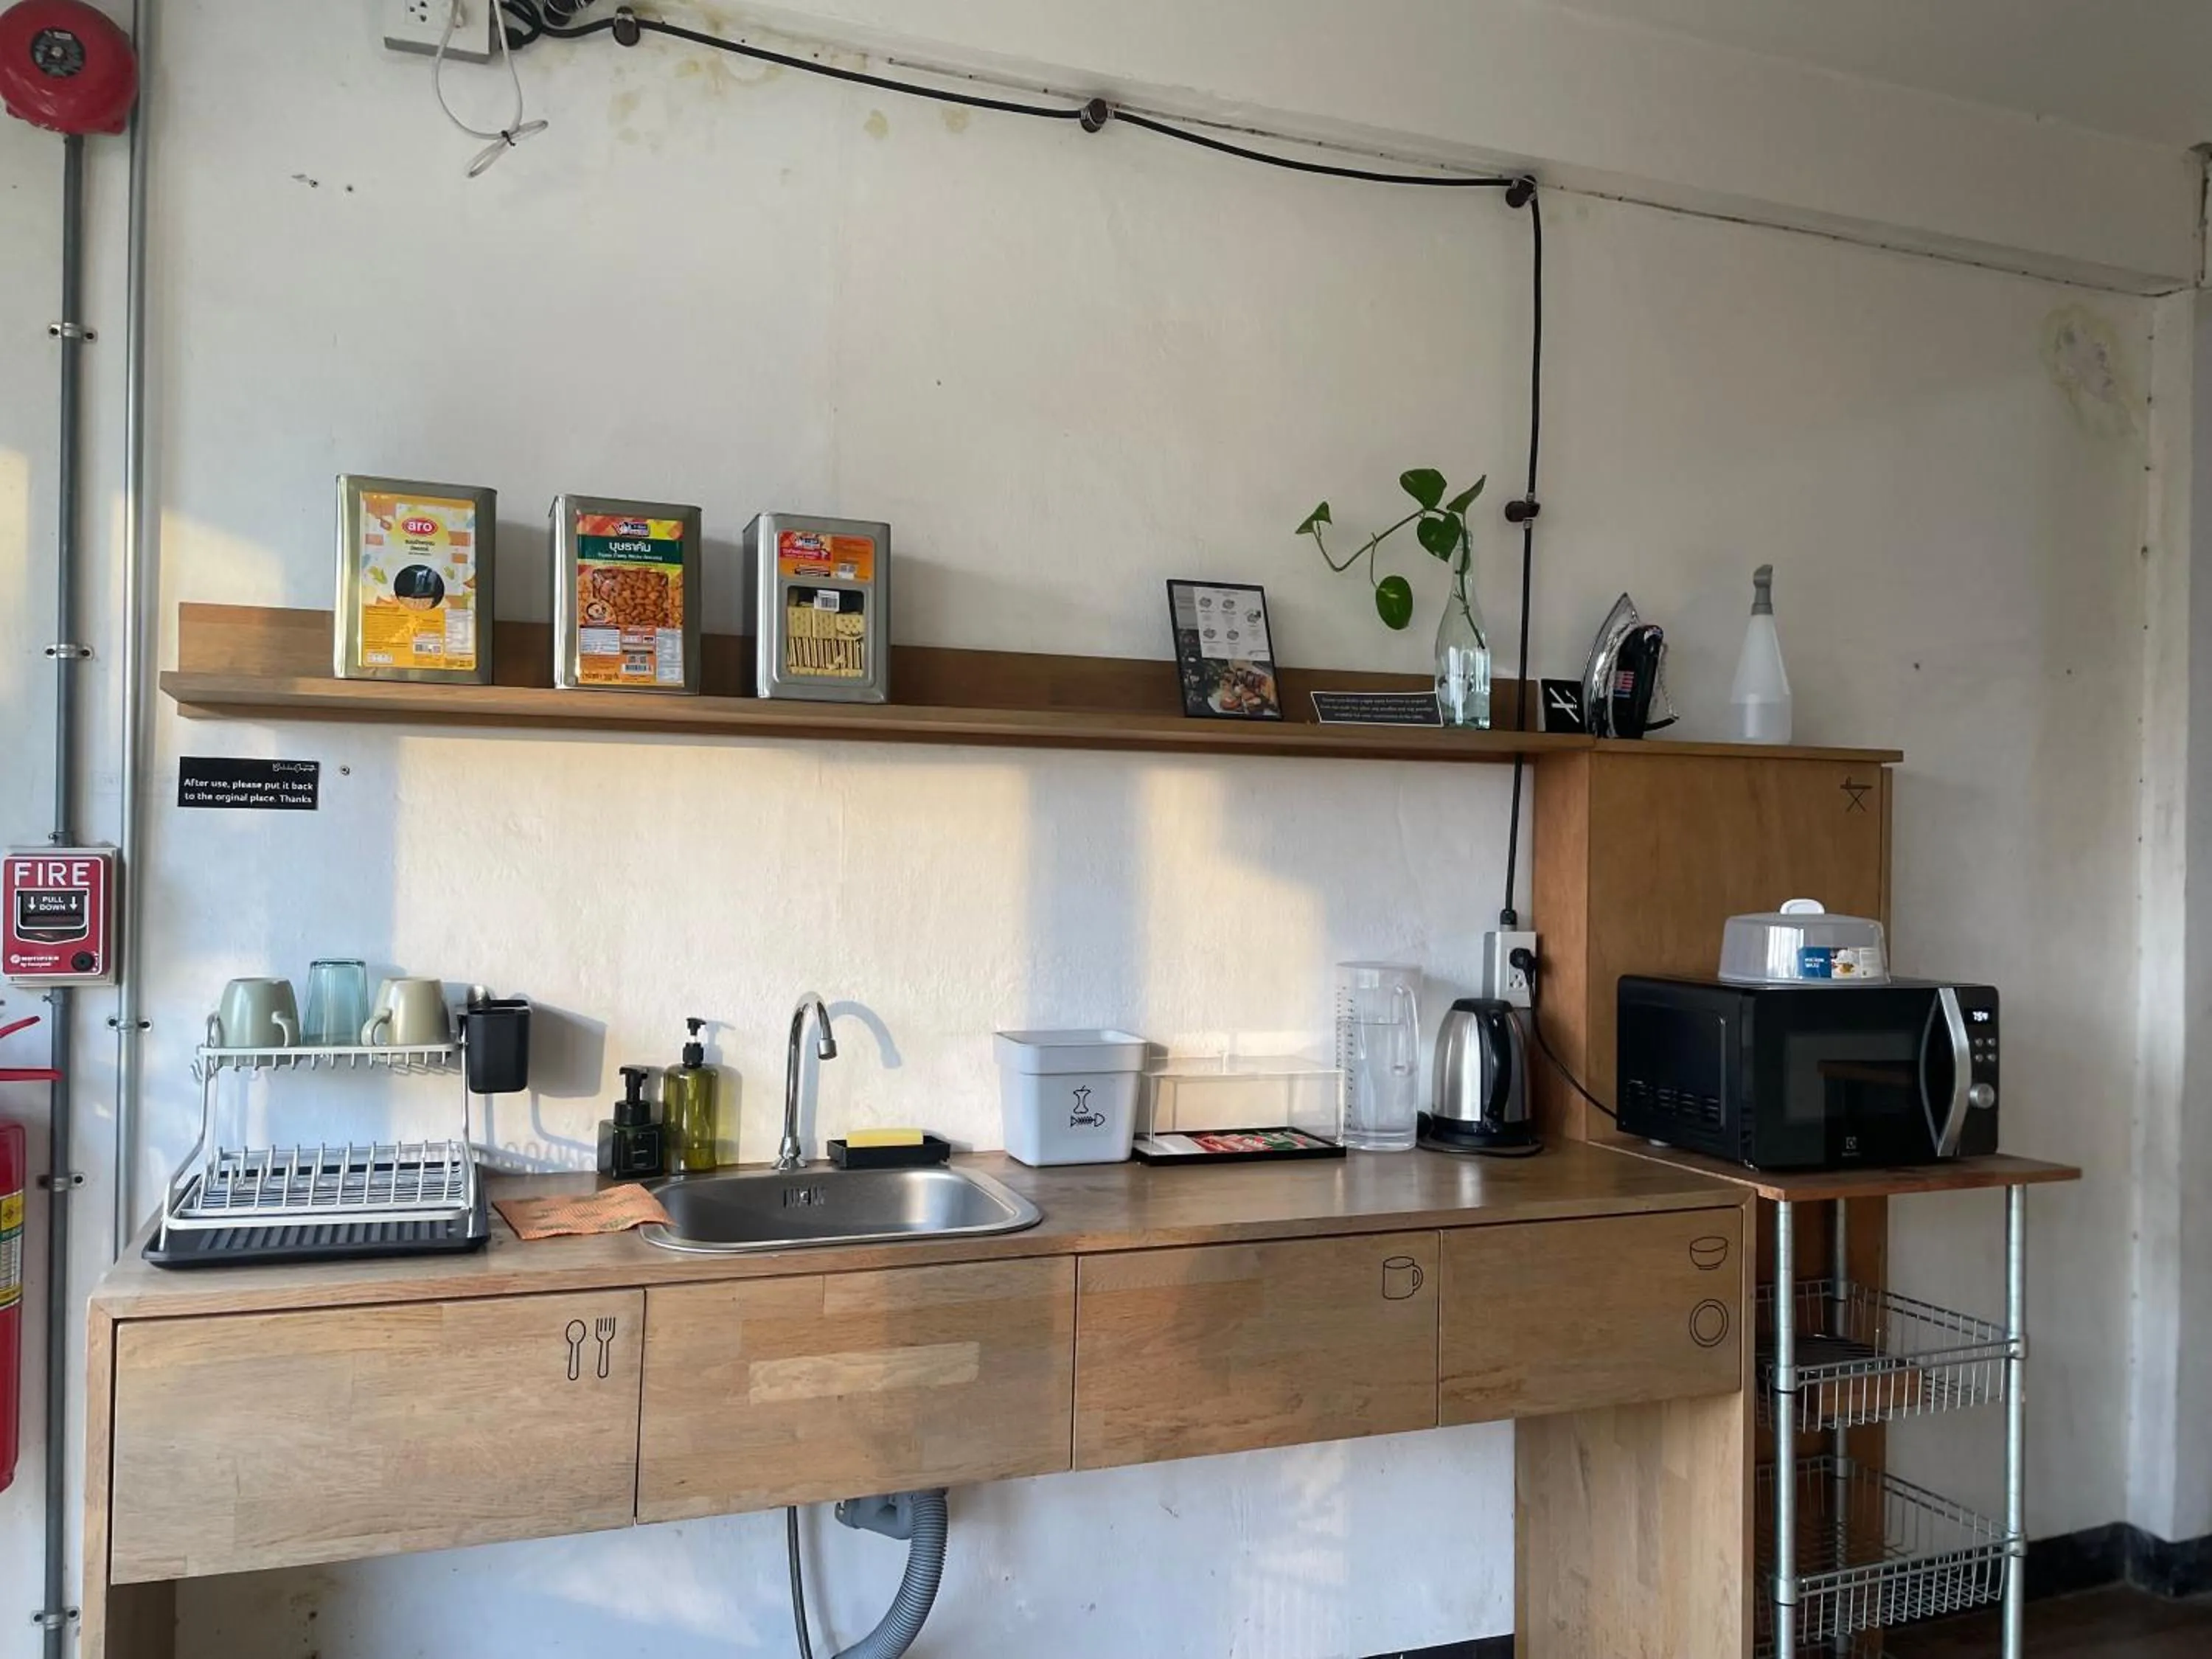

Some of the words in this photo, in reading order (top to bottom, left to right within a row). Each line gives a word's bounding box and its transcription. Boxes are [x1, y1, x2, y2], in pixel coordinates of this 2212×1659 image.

[408, 521, 433, 532] aro
[184, 778, 209, 787] After
[232, 779, 262, 790] please
[265, 782, 280, 791] put
[282, 781, 290, 790] it
[291, 781, 313, 790] back
[197, 792, 213, 800] the
[279, 794, 312, 803] Thanks
[14, 862, 91, 886] FIRE
[39, 903, 66, 911] DOWN
